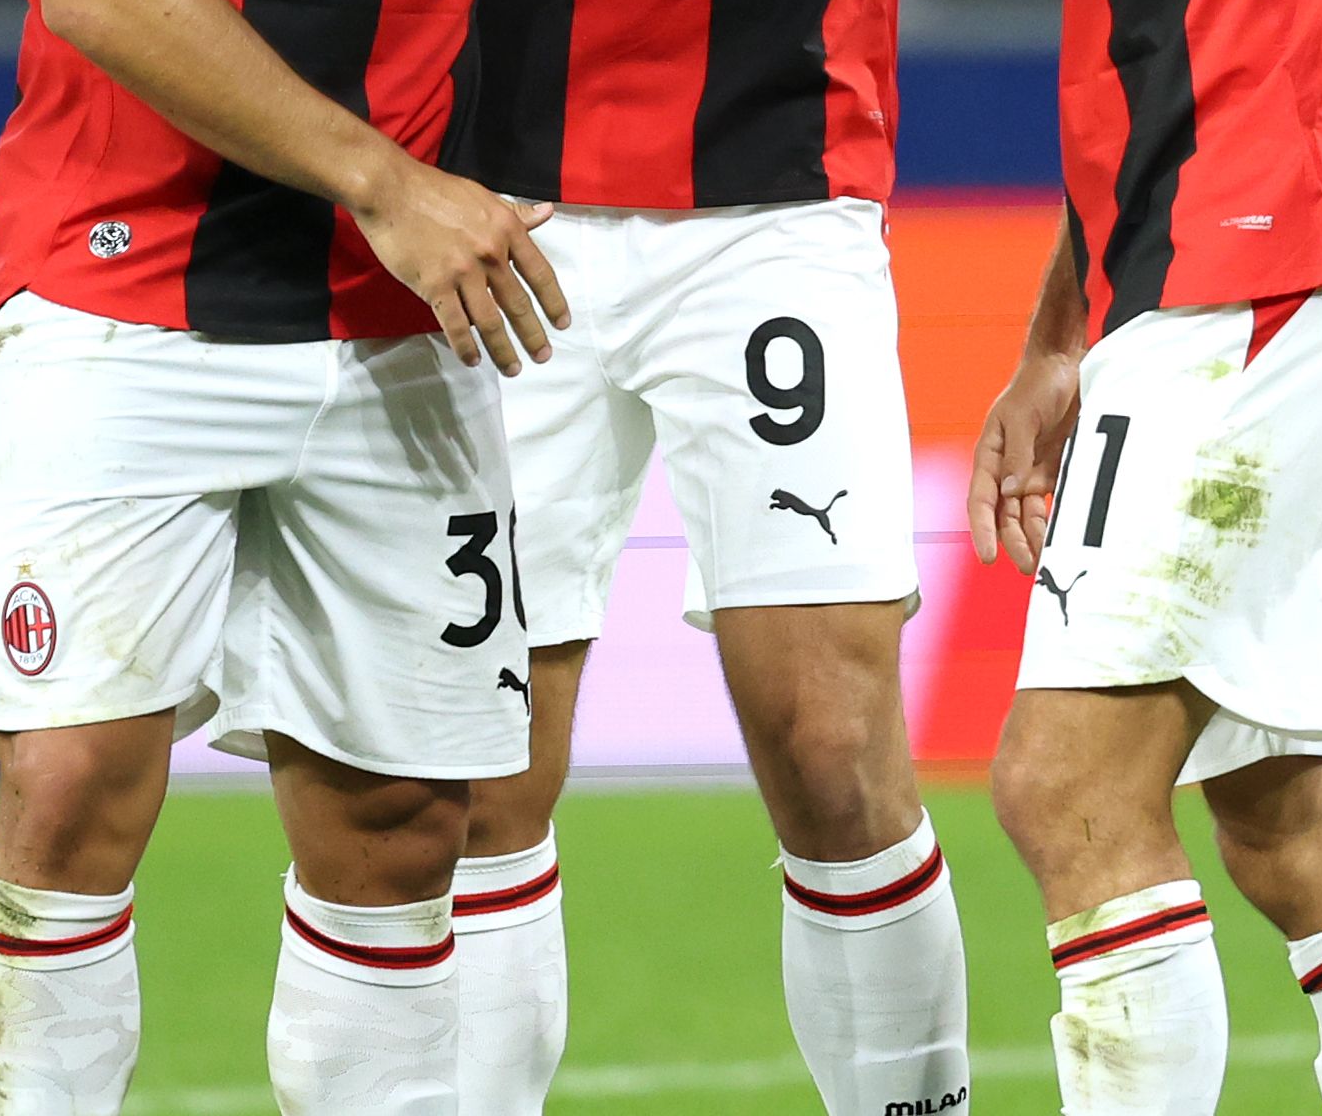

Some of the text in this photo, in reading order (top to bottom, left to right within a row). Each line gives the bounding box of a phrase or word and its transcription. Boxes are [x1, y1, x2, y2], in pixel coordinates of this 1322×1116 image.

[745, 316, 825, 446] 9
[12, 589, 40, 606] ACM
[440, 499, 527, 647] 3
[18, 653, 43, 664] 1899
